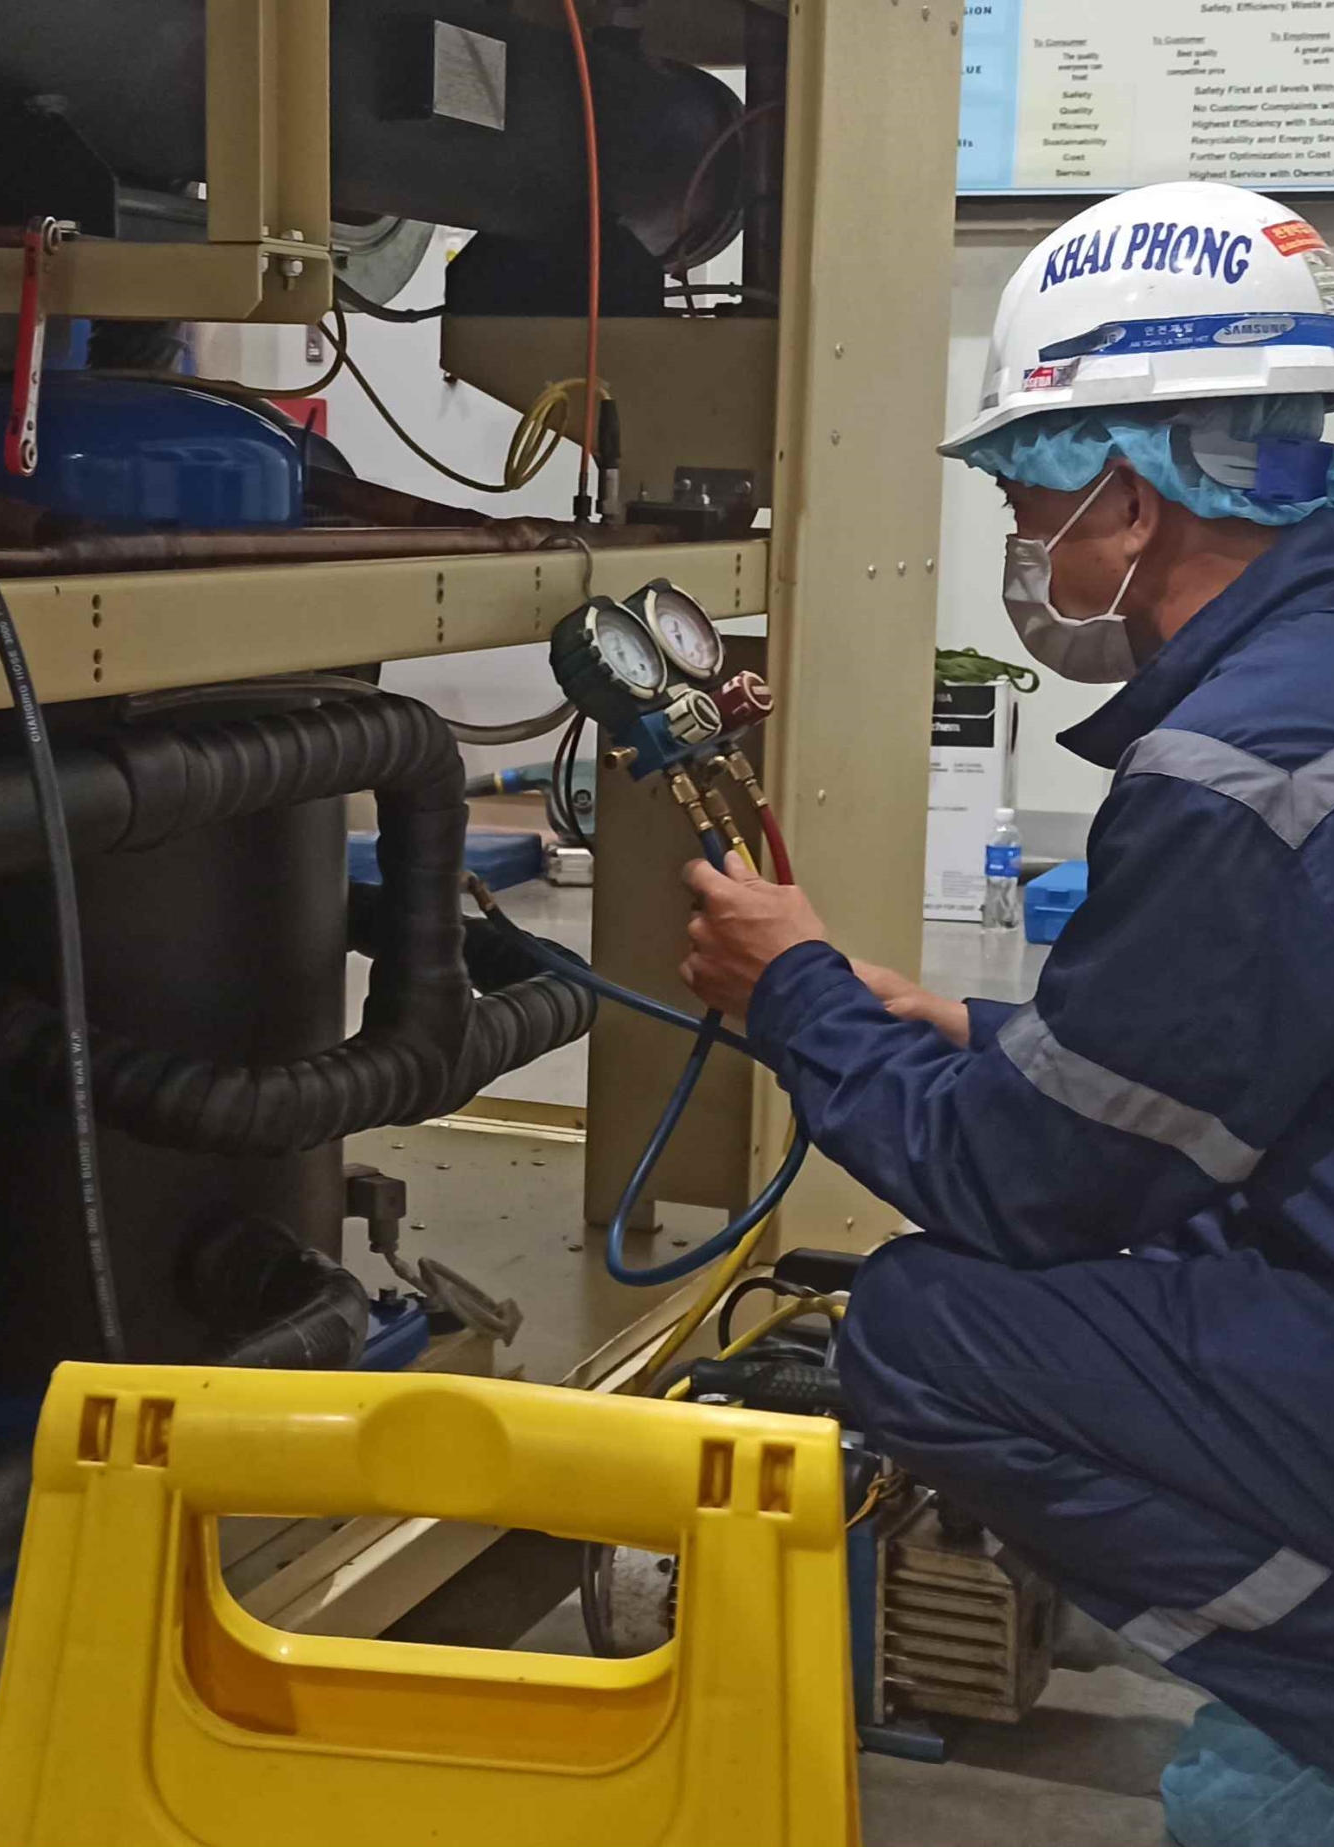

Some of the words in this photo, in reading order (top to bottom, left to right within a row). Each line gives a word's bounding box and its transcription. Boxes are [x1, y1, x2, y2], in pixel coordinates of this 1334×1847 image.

[1153, 37, 1163, 45] To
[1165, 36, 1205, 45] Customer
[1271, 32, 1281, 41] To
[1283, 32, 1330, 41] Employees
[1034, 39, 1044, 47] To
[1194, 86, 1225, 96] Safety
[1228, 85, 1251, 94] First
[1253, 86, 1263, 94] at
[1265, 85, 1278, 94] all
[1280, 84, 1309, 93] levels
[1062, 91, 1092, 100] Safety
[1060, 107, 1093, 117] Quality
[1193, 104, 1208, 112] No
[1210, 103, 1258, 112] Customer
[1261, 102, 1318, 113] Complaints
[1052, 122, 1100, 132] Efficiency
[1192, 119, 1230, 130] Highest
[1233, 119, 1282, 129] Efficiency
[1284, 118, 1307, 127] with
[1043, 137, 1107, 147] Sustainability
[1191, 135, 1254, 146] Recyclability
[1257, 135, 1276, 144] and
[1278, 134, 1315, 145] Energy
[1062, 153, 1085, 161] Cost
[1189, 152, 1226, 161] Further
[1229, 150, 1293, 161] Optimization
[1295, 150, 1305, 159] in
[1307, 150, 1331, 159] Cost
[1056, 169, 1091, 178] Service
[1189, 170, 1227, 180] Highest
[1230, 169, 1267, 179] Service
[1269, 169, 1291, 178] with
[1040, 225, 1121, 293] KHAI
[1121, 222, 1252, 284] PHONG
[1224, 323, 1287, 335] SAMSUNG
